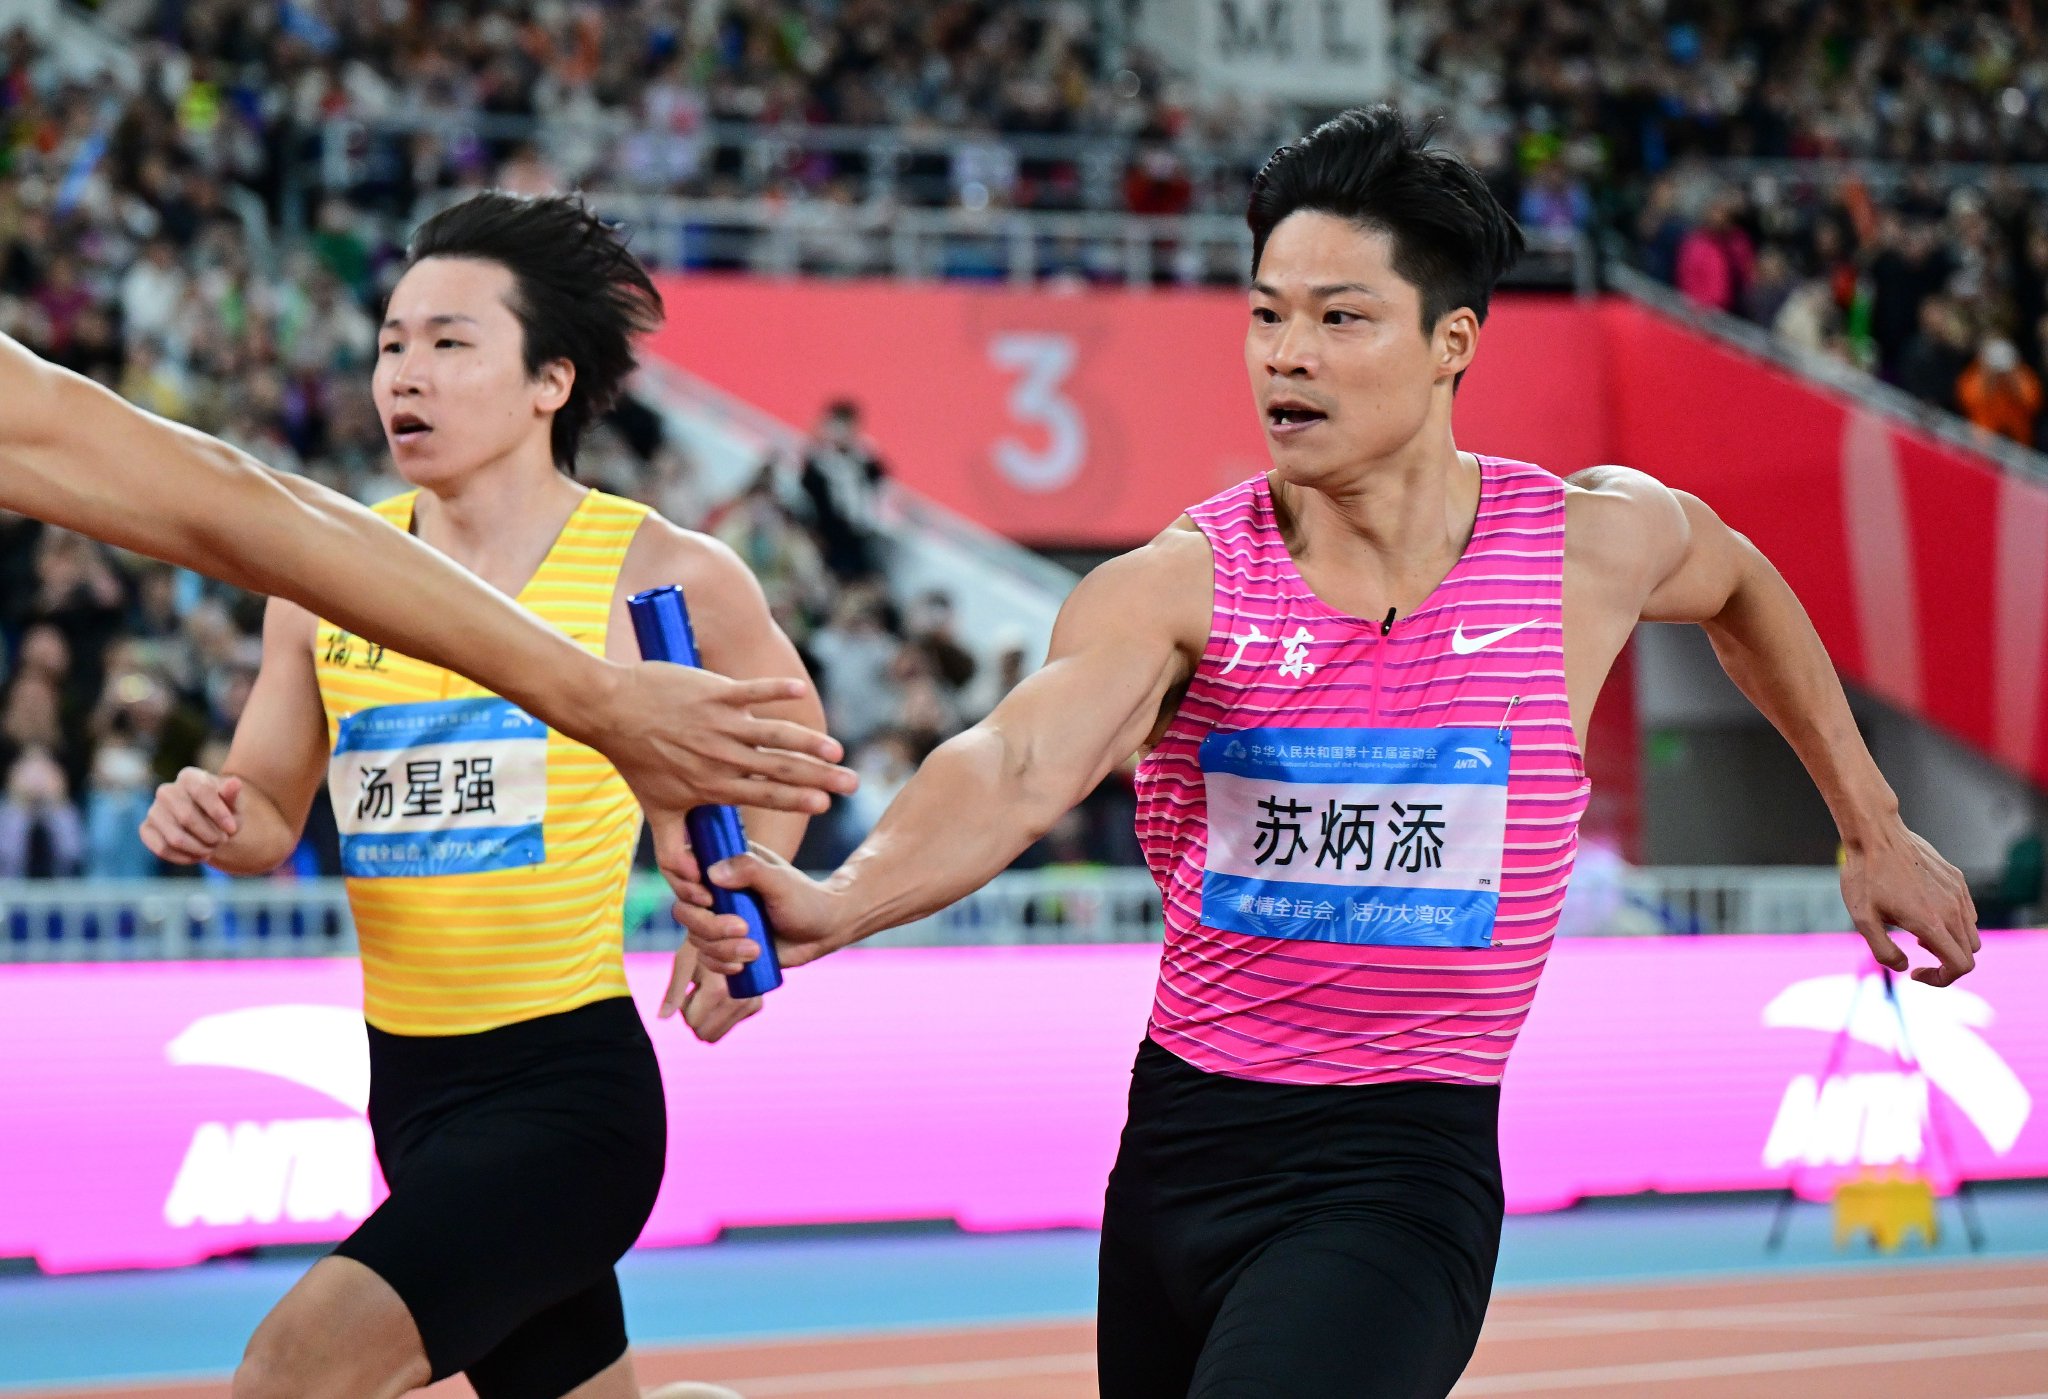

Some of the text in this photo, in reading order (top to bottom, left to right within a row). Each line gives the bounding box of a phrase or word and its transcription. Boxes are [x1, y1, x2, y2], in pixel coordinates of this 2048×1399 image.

[986, 331, 1089, 492] 3
[1218, 624, 1315, 679] 广东
[1251, 745, 1438, 759] 中华人民共和国第十五届运动会
[1454, 760, 1478, 769] ANTA
[357, 757, 496, 820] 汤星强
[1253, 795, 1445, 872] 苏炳添
